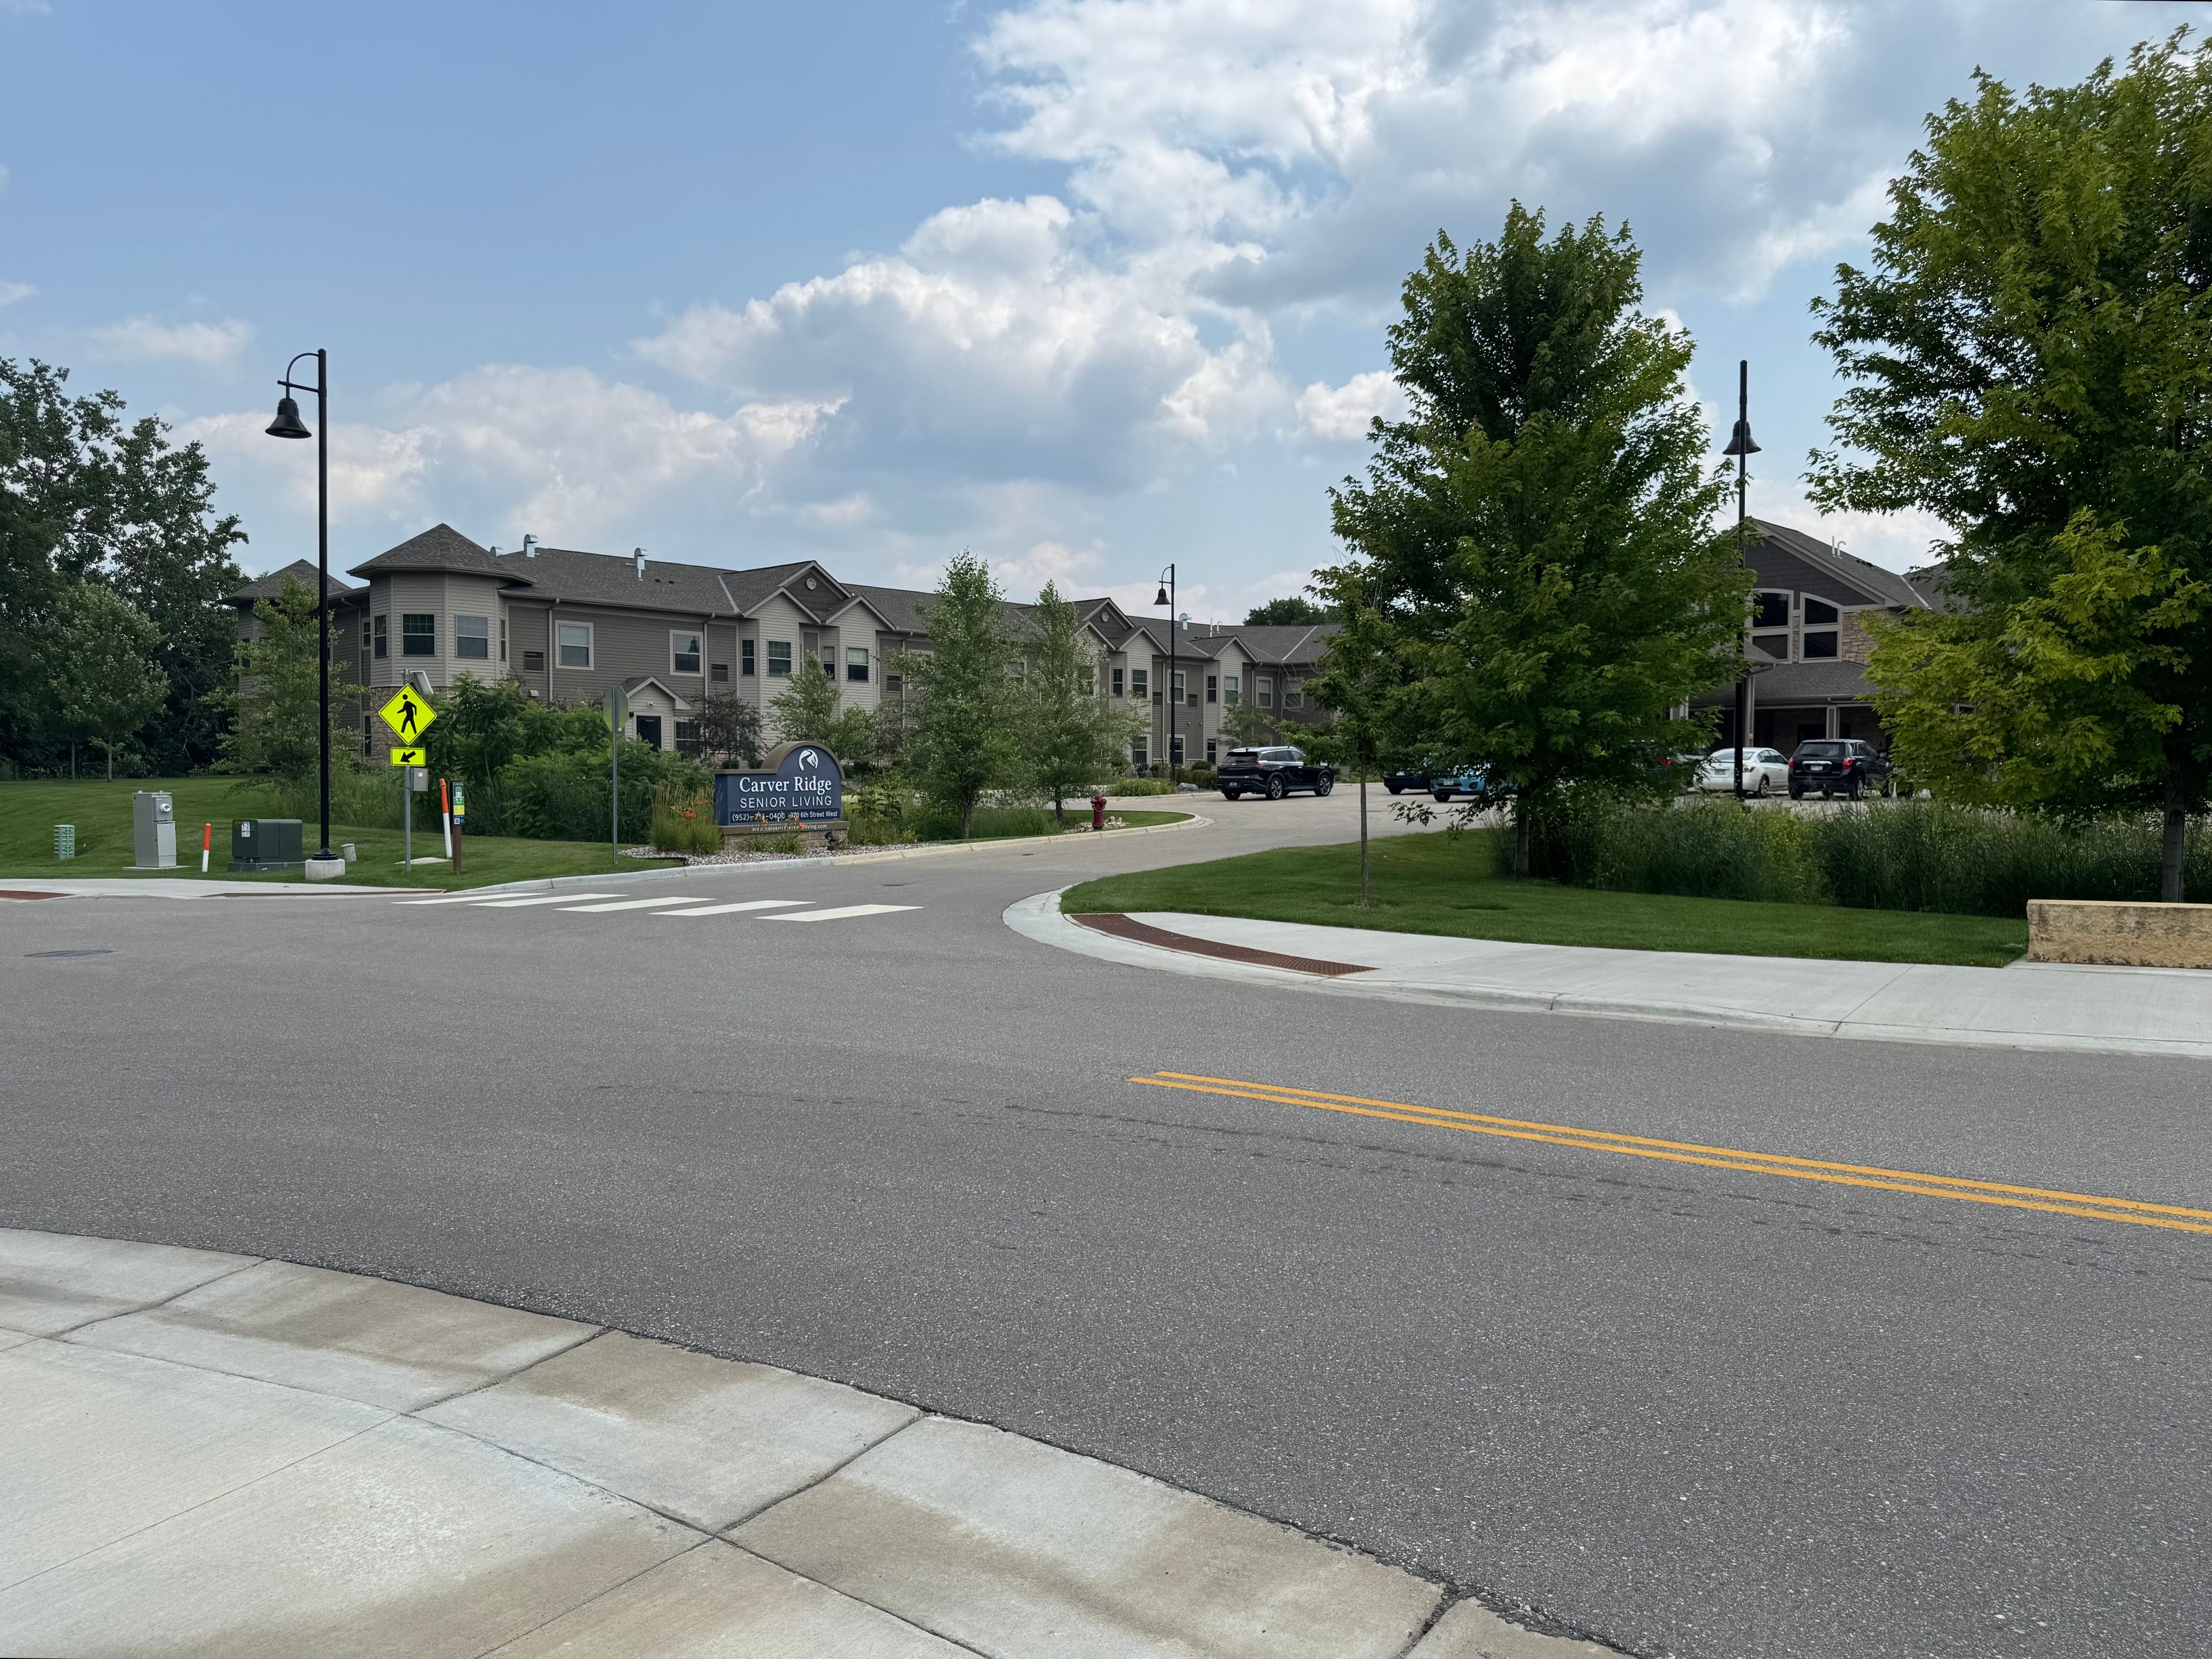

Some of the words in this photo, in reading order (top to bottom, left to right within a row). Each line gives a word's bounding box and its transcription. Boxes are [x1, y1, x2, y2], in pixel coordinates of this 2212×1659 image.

[740, 777, 789, 792] Carver
[794, 775, 832, 795] Ridge
[740, 797, 786, 808] SENIOR
[793, 796, 832, 806] LIVING
